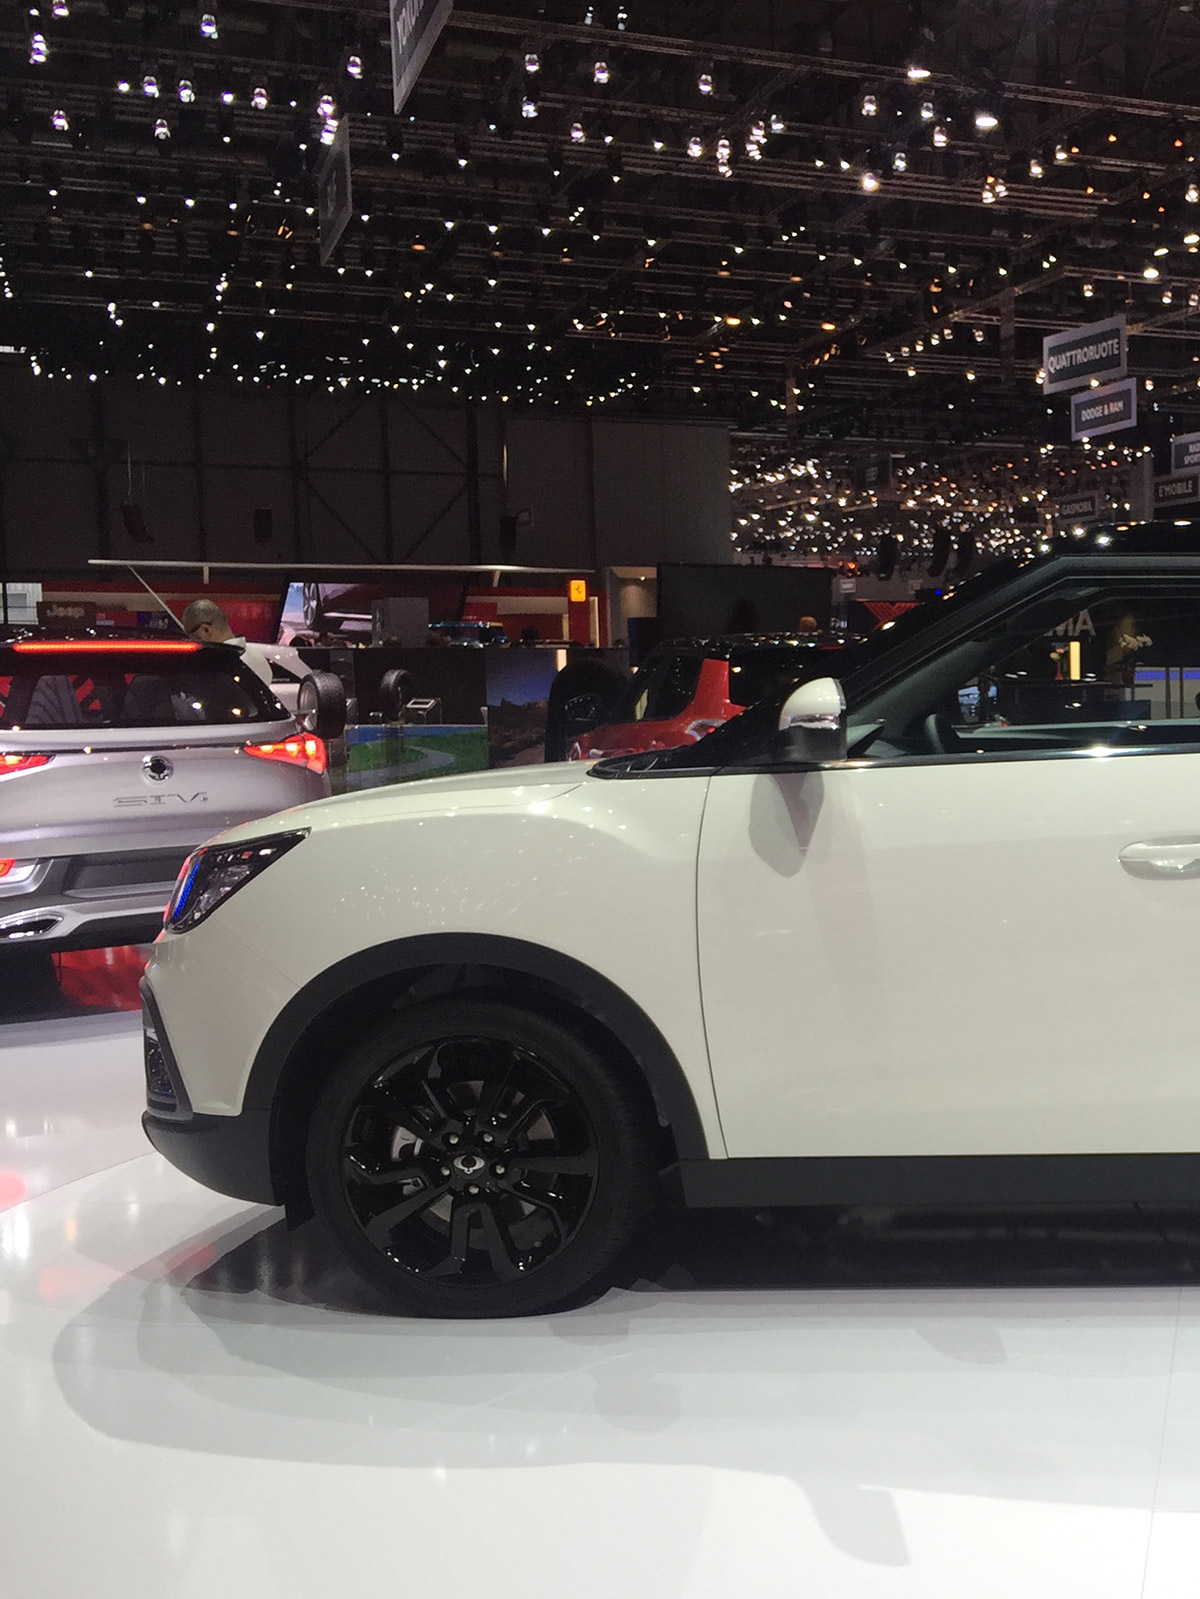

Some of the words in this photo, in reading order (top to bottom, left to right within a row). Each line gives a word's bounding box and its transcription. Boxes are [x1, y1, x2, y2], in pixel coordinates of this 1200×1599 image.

[1047, 337, 1120, 375] QUATTRORUOTE
[1081, 408, 1103, 421] DODGE
[1109, 400, 1124, 414] RAM
[46, 603, 85, 620] Jeep
